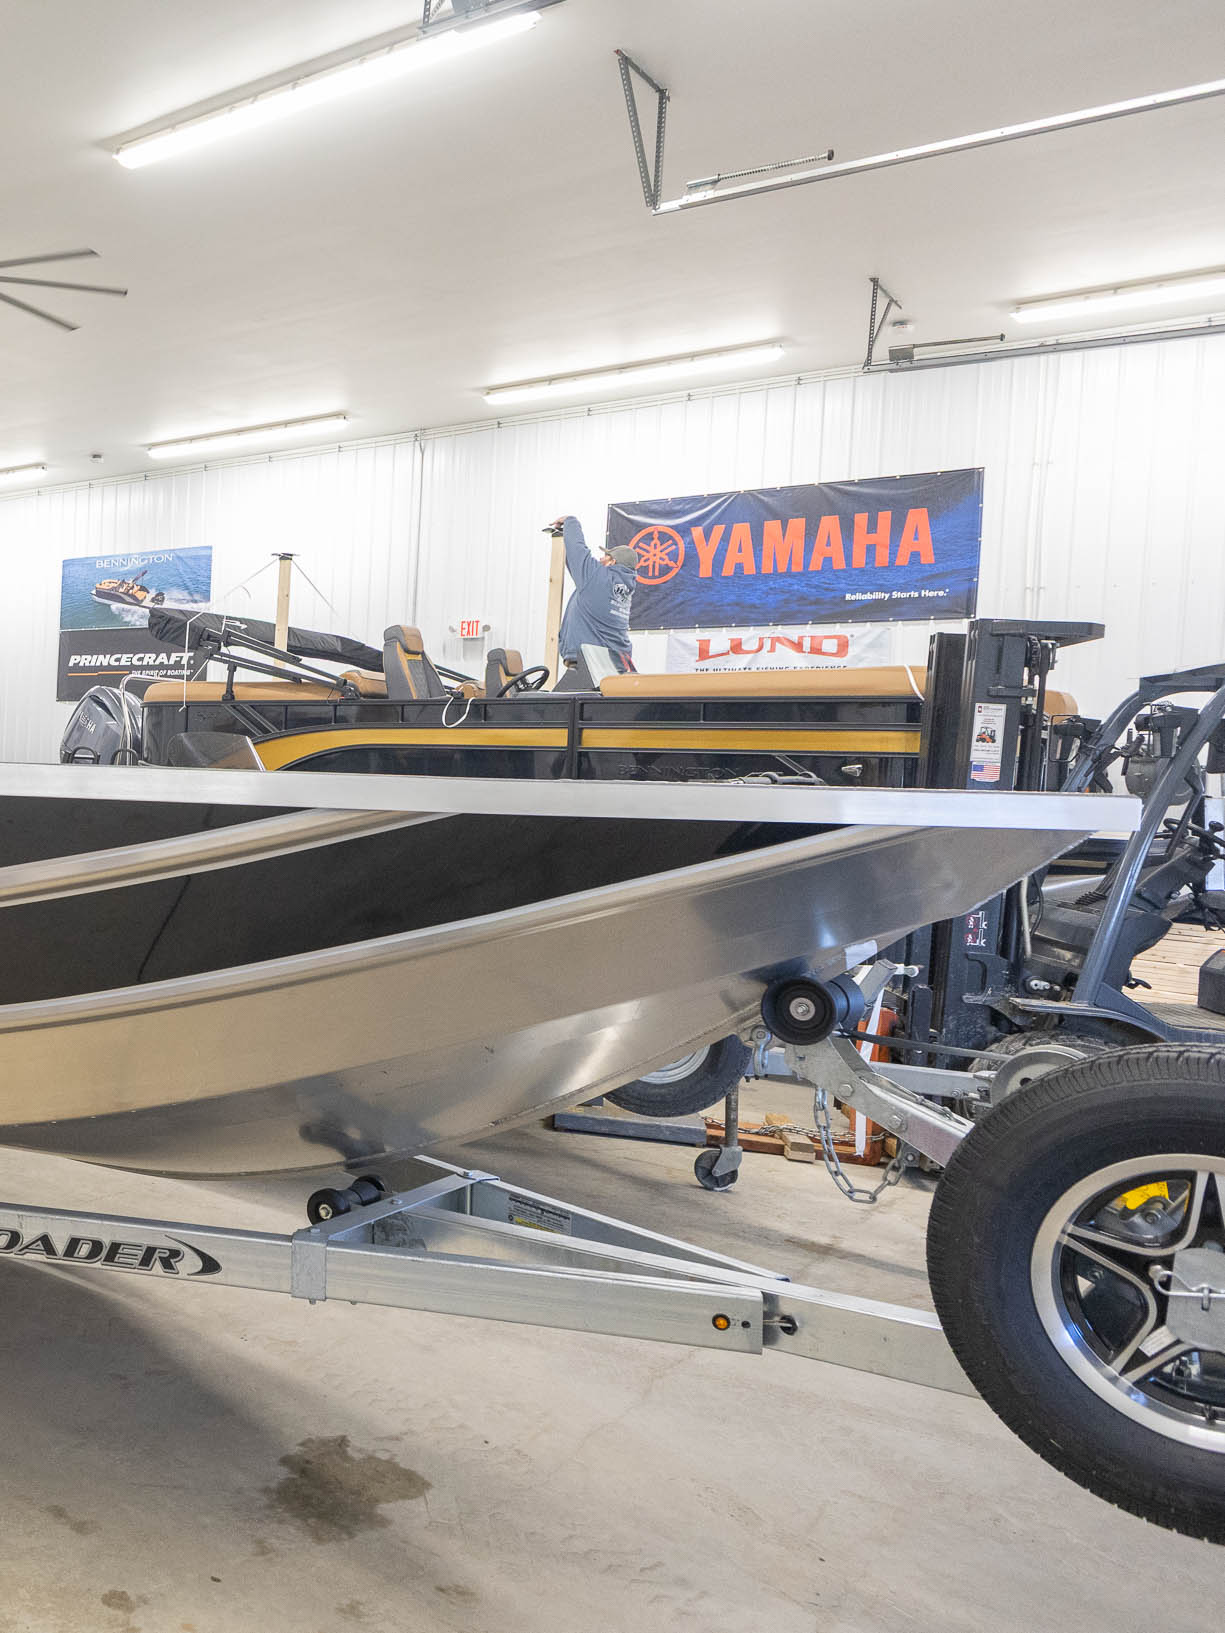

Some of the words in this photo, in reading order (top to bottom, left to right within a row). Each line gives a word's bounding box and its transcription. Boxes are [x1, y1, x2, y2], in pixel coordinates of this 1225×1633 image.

[690, 508, 936, 578] YAMAHA
[95, 553, 173, 568] BENNINGTON
[845, 591, 890, 601] Reliability
[891, 590, 919, 599] Starts
[460, 620, 480, 637] EXIT
[695, 634, 849, 662] LUND
